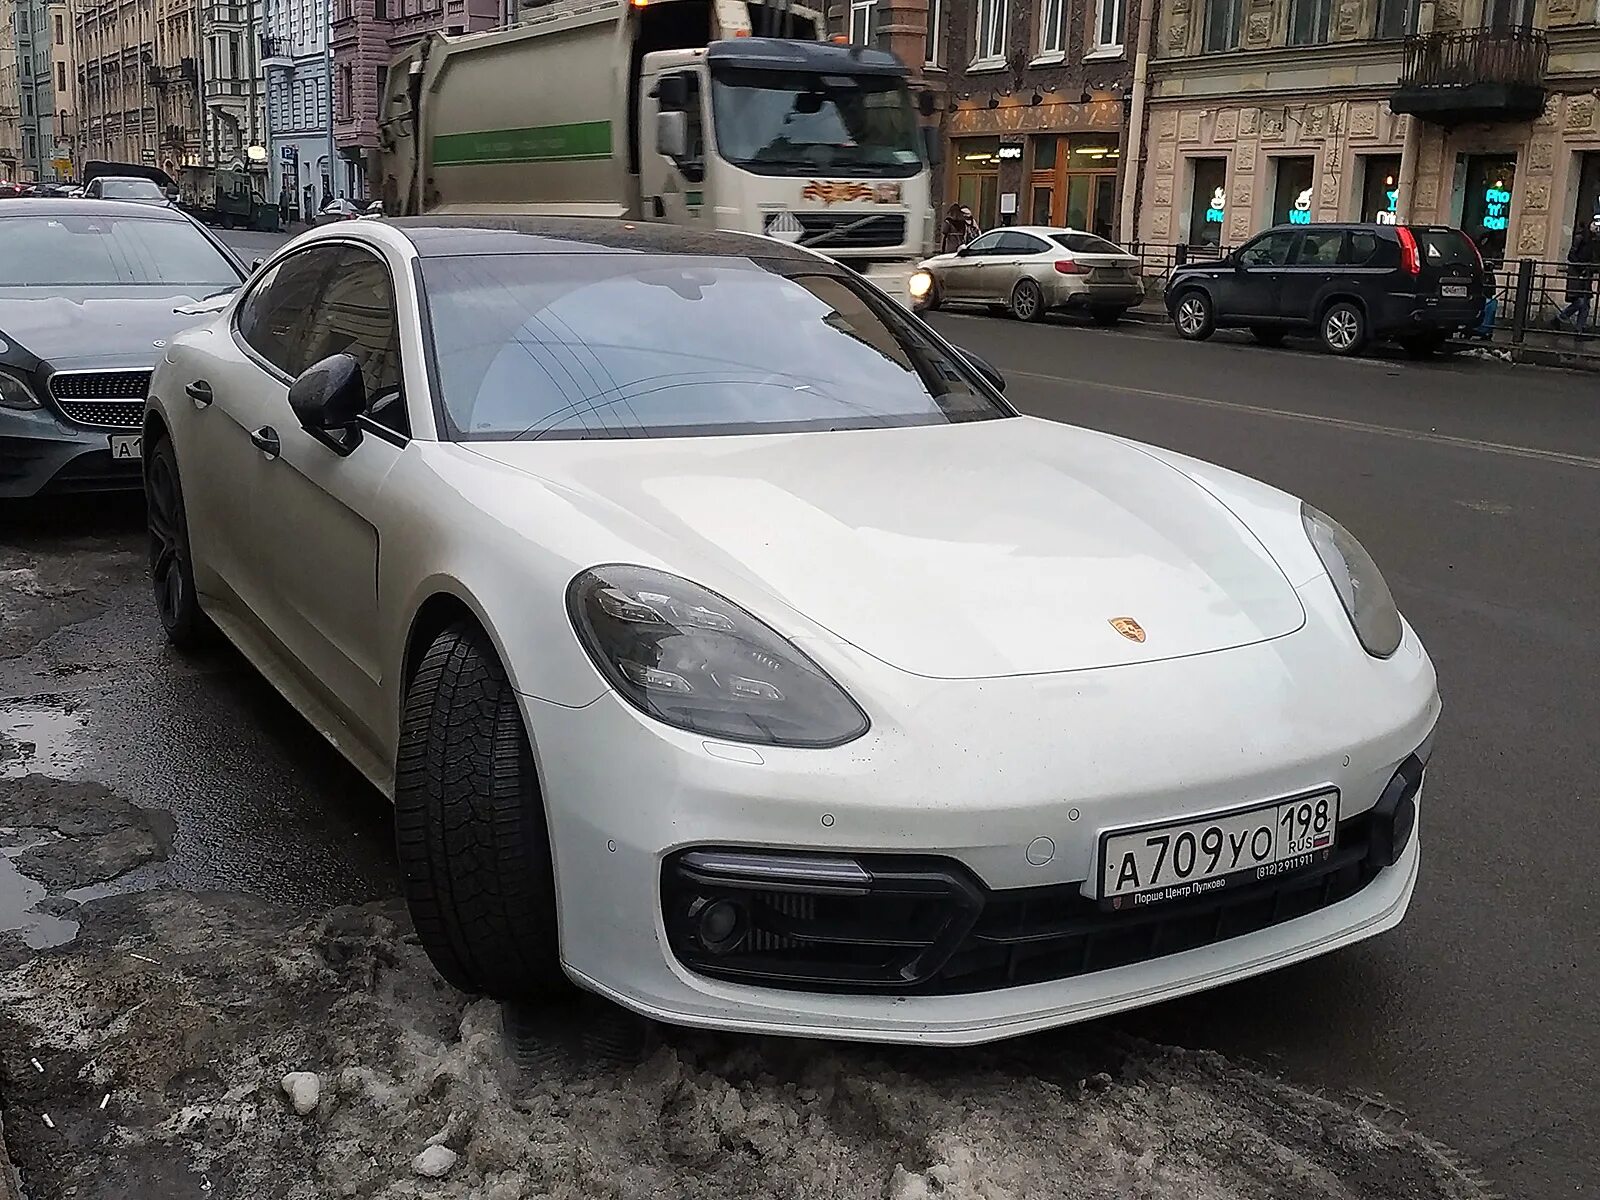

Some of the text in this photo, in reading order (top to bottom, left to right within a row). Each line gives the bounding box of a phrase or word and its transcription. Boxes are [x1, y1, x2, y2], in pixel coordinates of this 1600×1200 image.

[1280, 799, 1329, 842] 198
[1288, 836, 1313, 854] RUS
[1256, 863, 1277, 880] (812)
[1134, 879, 1226, 905] Порше Центр Пулково
